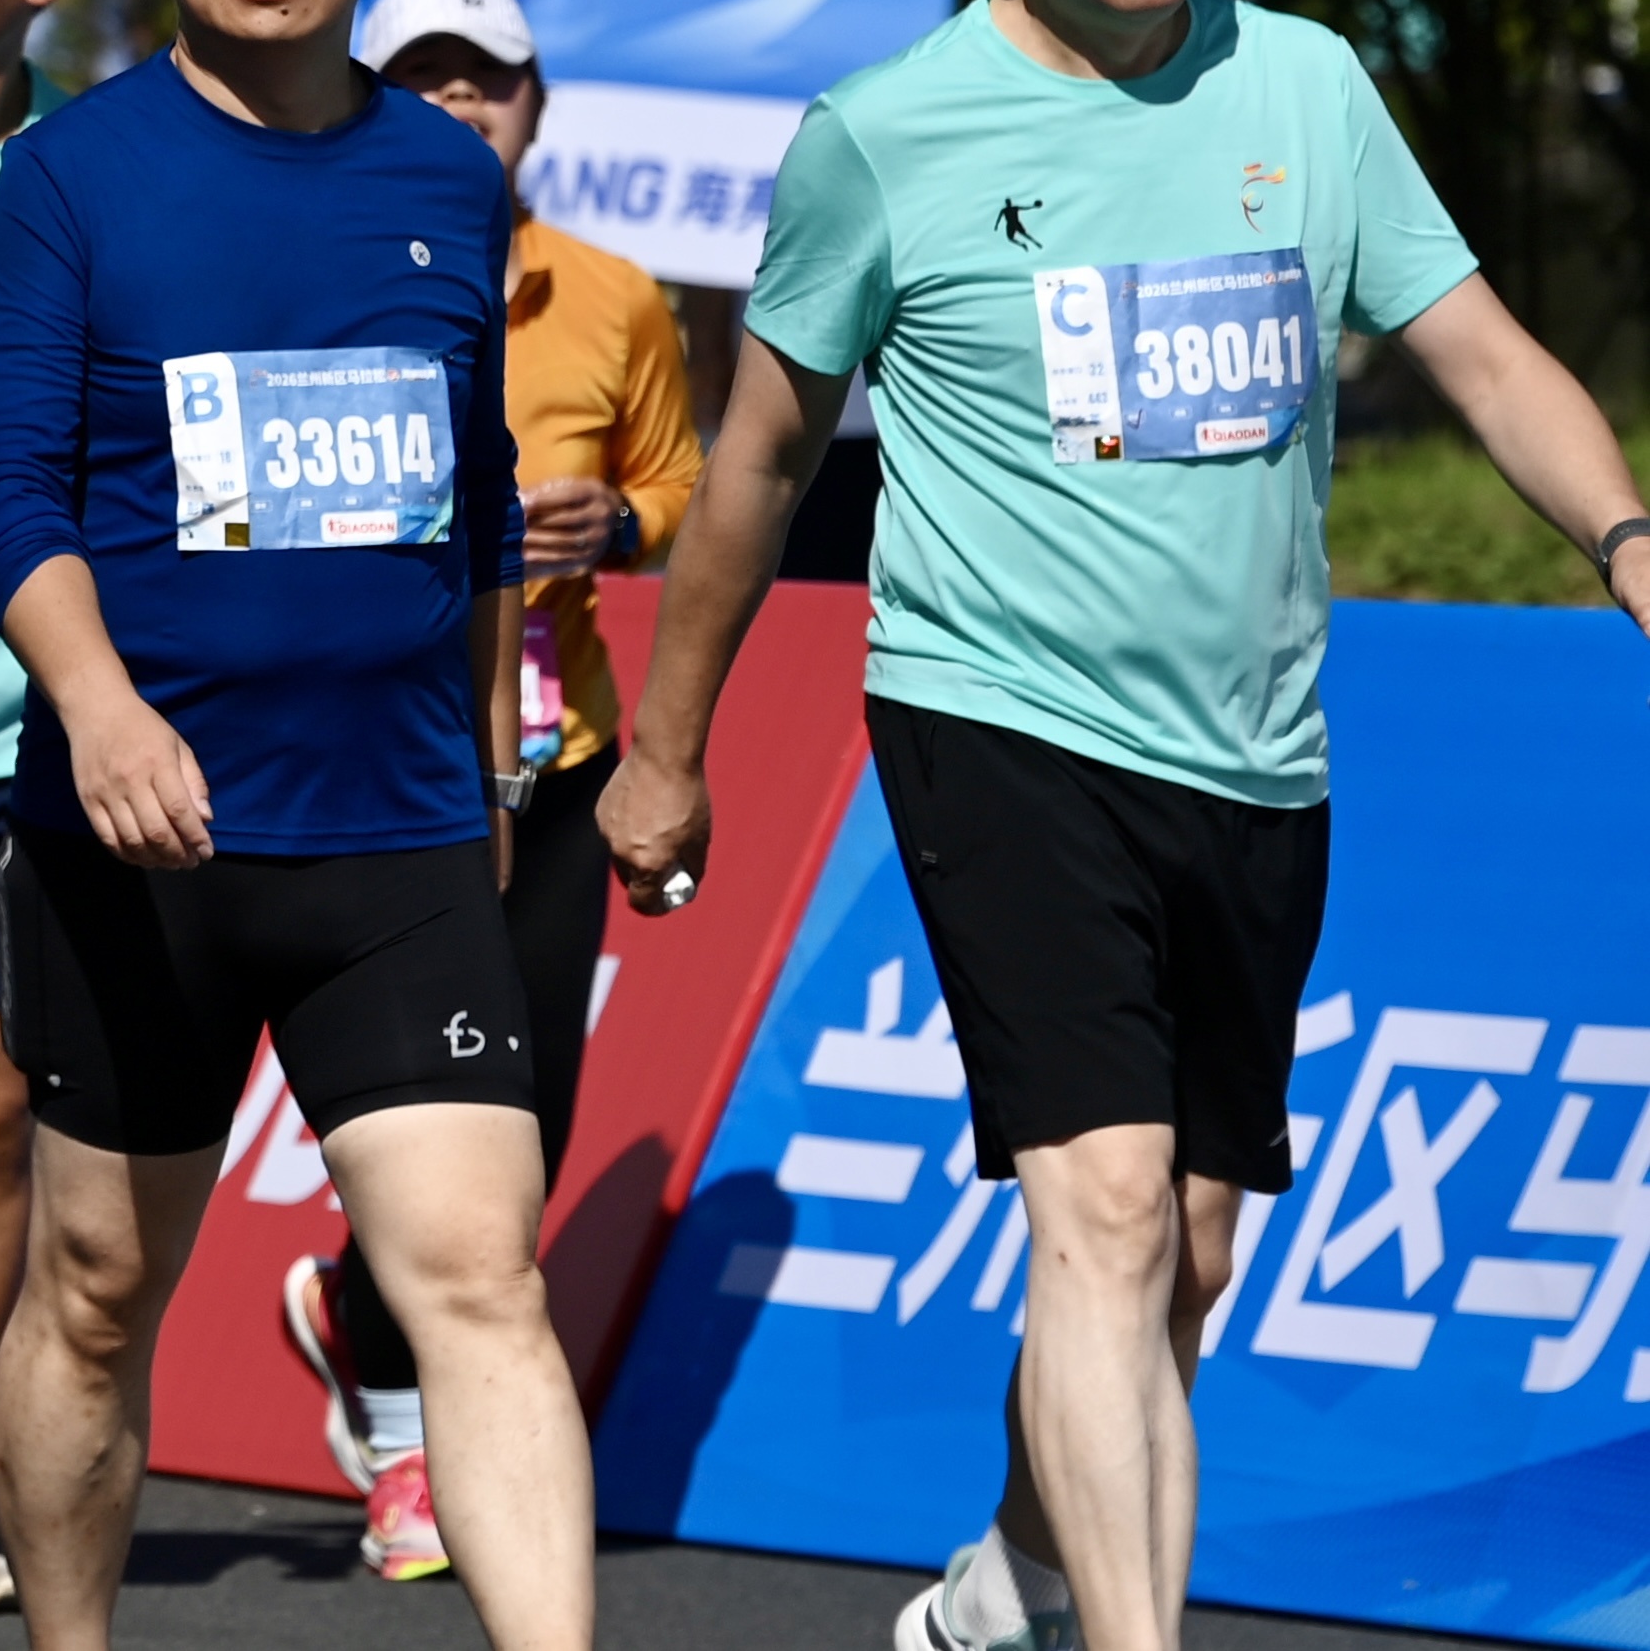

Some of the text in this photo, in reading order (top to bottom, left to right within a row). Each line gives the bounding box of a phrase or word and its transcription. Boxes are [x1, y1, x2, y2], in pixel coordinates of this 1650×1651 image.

[1050, 283, 1094, 337] C
[1136, 271, 1264, 300] 2026兰州新区马拉松
[1133, 314, 1303, 400] 38041
[181, 371, 224, 426] B
[262, 413, 436, 489] 33614
[1213, 428, 1266, 442] QIAODAN
[338, 521, 395, 534] QIAODAN
